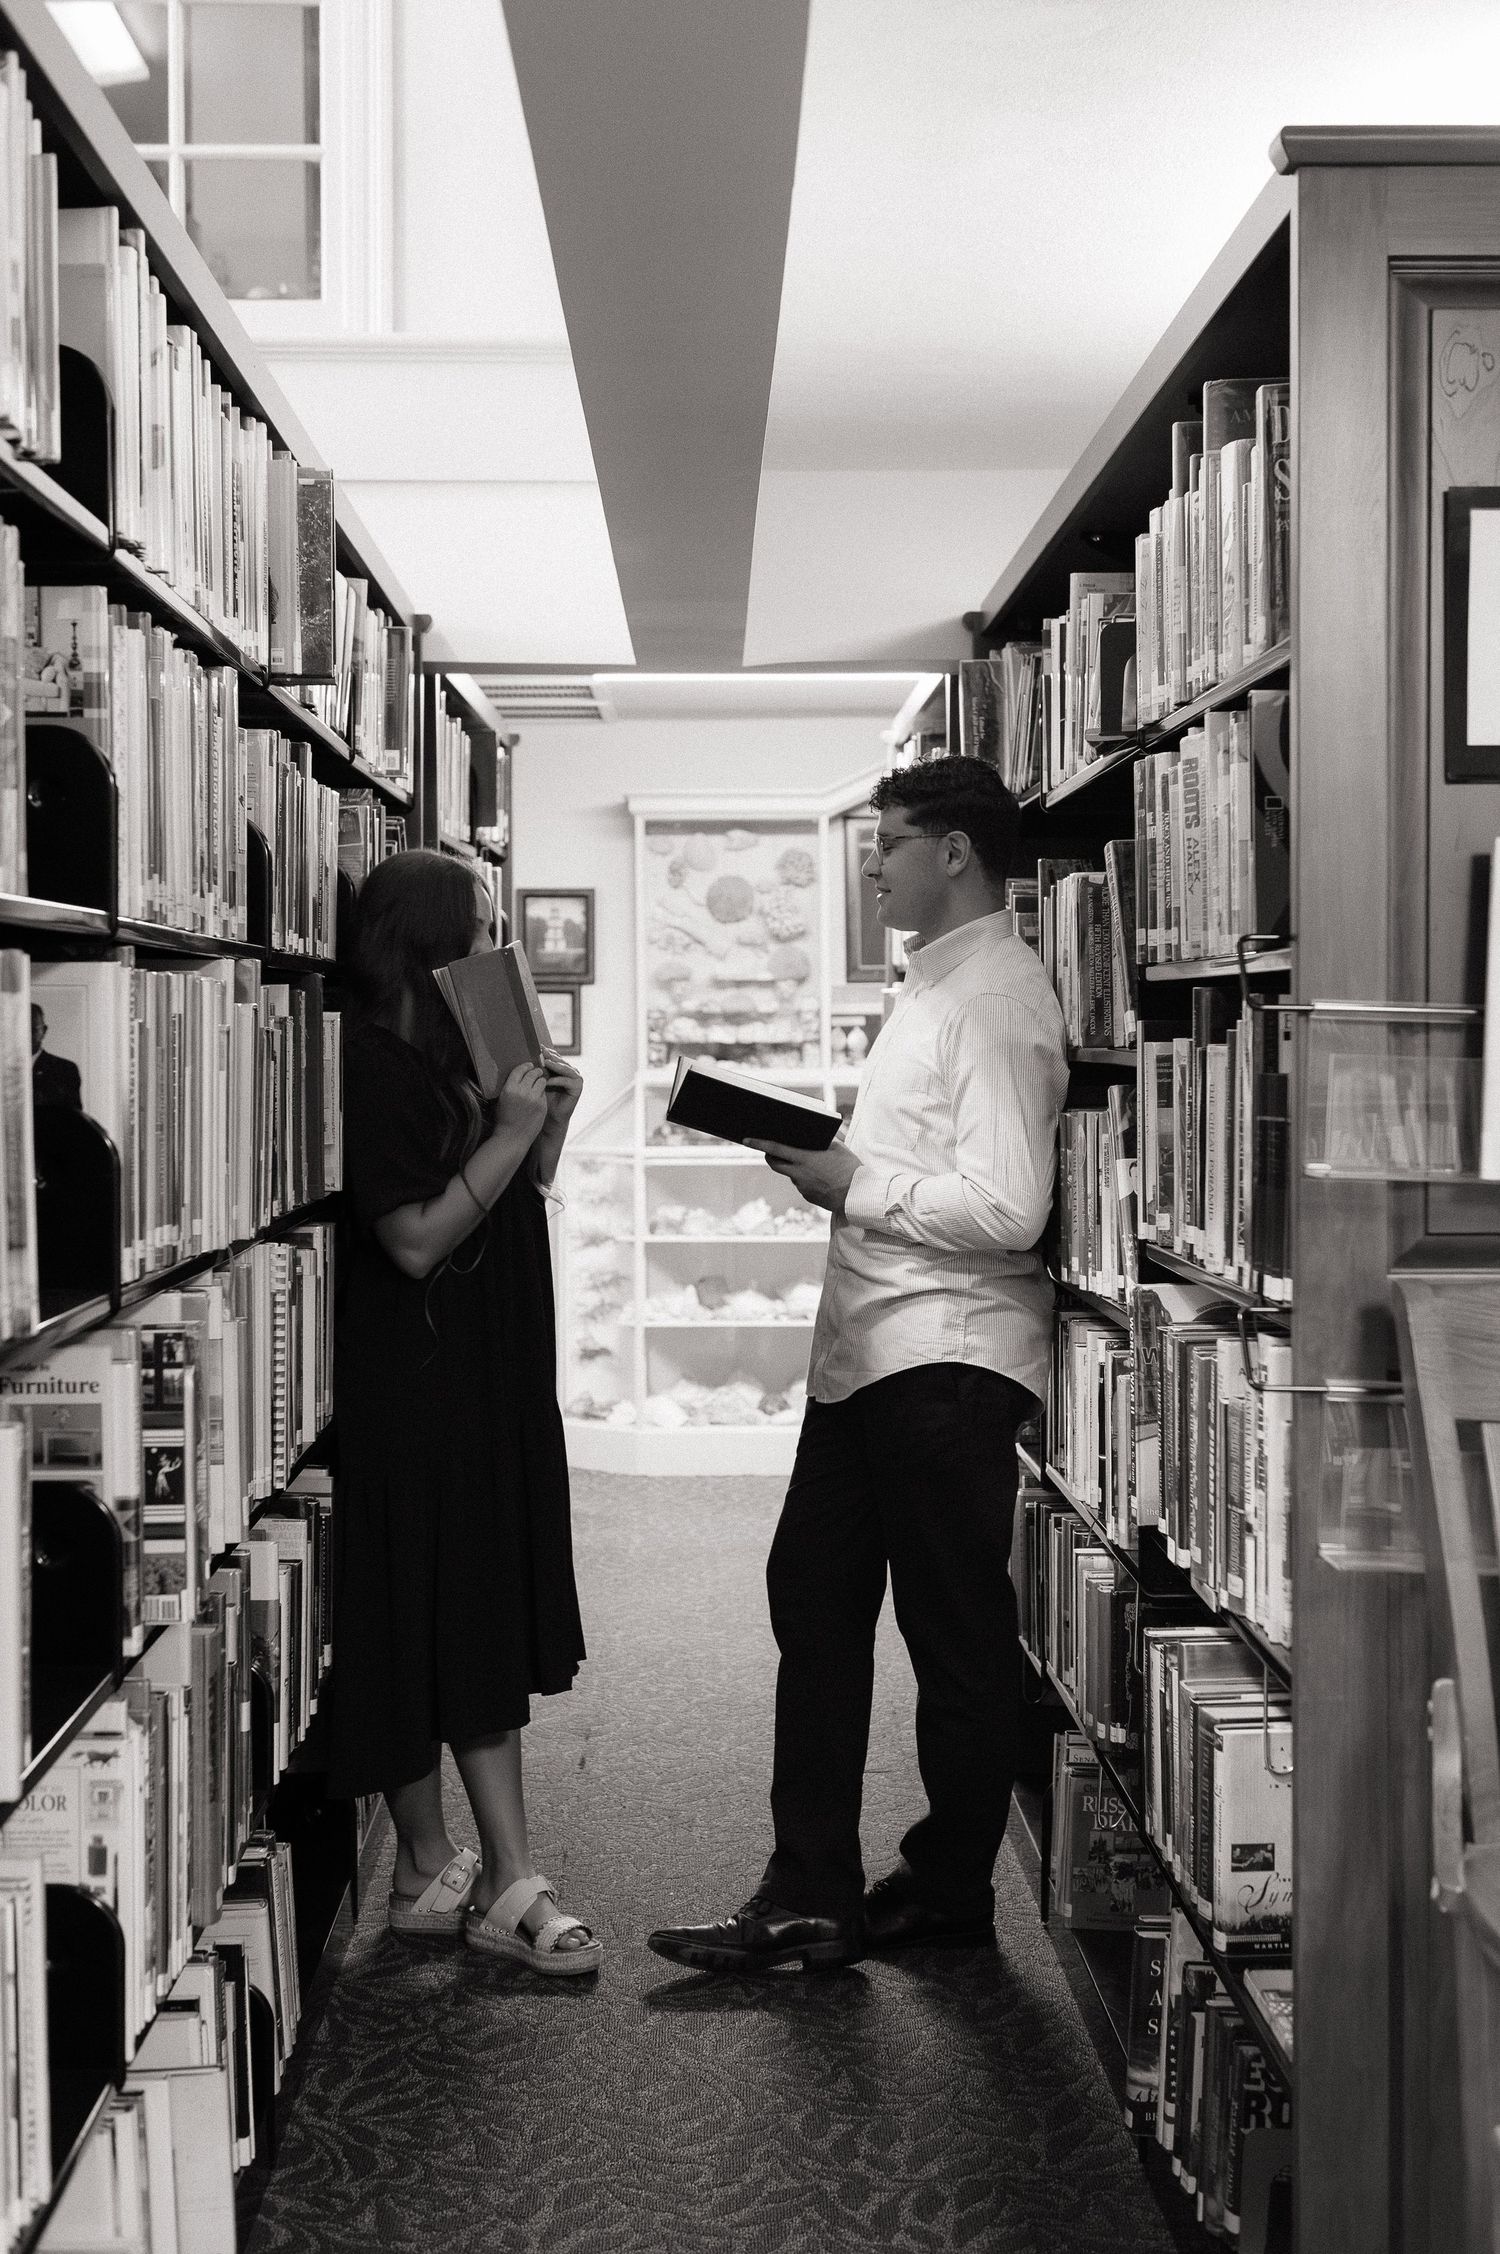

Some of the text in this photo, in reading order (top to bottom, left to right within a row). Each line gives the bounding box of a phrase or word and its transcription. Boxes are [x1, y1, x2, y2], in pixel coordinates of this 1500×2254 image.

[1182, 756, 1201, 830] ROOTS
[1162, 810, 1171, 840] TRACY
[1185, 836, 1194, 896] HALEY
[1193, 837, 1202, 884] ALEX
[1101, 886, 1110, 907] MORE
[1163, 865, 1172, 910] HEPBURN
[1094, 924, 1102, 943] FIFTH
[1101, 908, 1110, 928] THAN
[1094, 944, 1102, 972] REVISED
[1102, 943, 1111, 988] MAGNIFICENT
[1089, 1012, 1097, 1036] LINCOLN
[1103, 988, 1112, 1037] ILLUSTRATIONS
[1208, 1111, 1216, 1153] GREAT
[1185, 1086, 1193, 1223] Time Detectives
[1208, 1158, 1216, 1221] PYRAMID
[1141, 1346, 1159, 1365] W
[0, 1376, 100, 1395] Furniture
[1244, 1390, 1253, 1437] GENERAL
[16, 1793, 67, 1812] OLOR
[1200, 1775, 1210, 1836] BITTER
